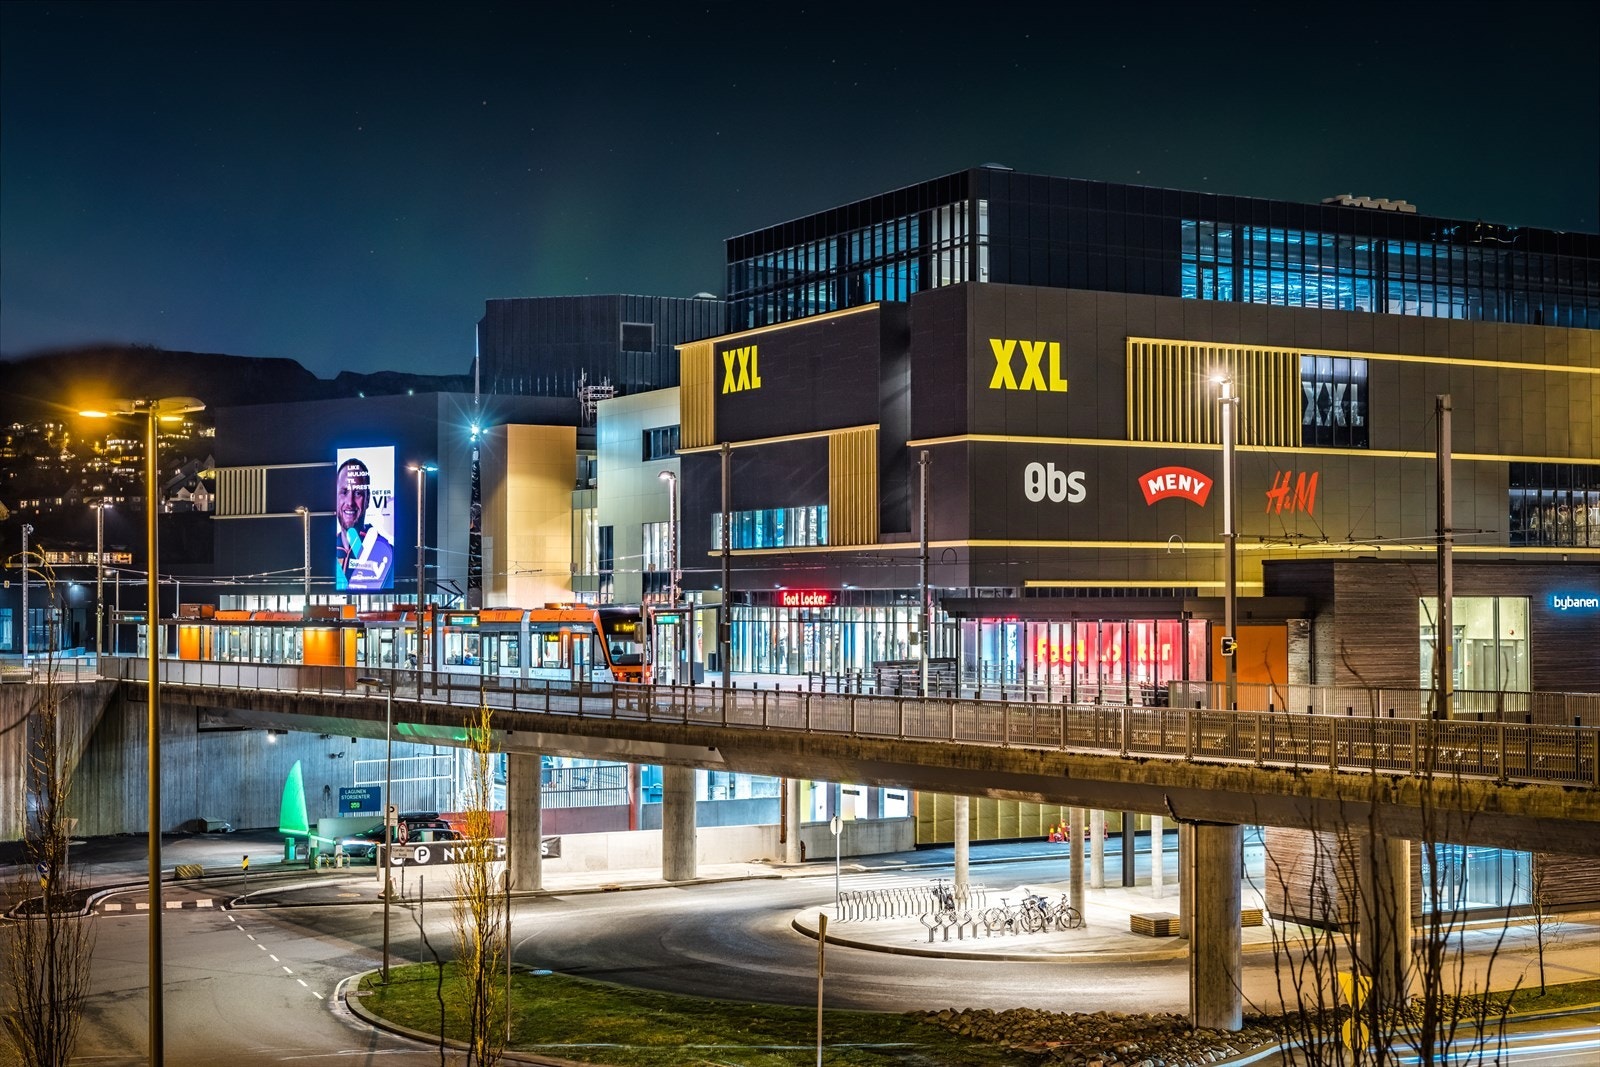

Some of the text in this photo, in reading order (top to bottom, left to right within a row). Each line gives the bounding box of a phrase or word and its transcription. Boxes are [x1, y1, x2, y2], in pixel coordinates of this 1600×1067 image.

[722, 345, 761, 394] XXL
[989, 338, 1067, 392] XXL
[1302, 381, 1364, 427] XXL
[1024, 461, 1087, 503] Obs
[1147, 473, 1206, 495] MENY
[1265, 470, 1319, 515] H&M
[783, 592, 827, 606] Foot Locker
[1553, 595, 1599, 610] bybanen
